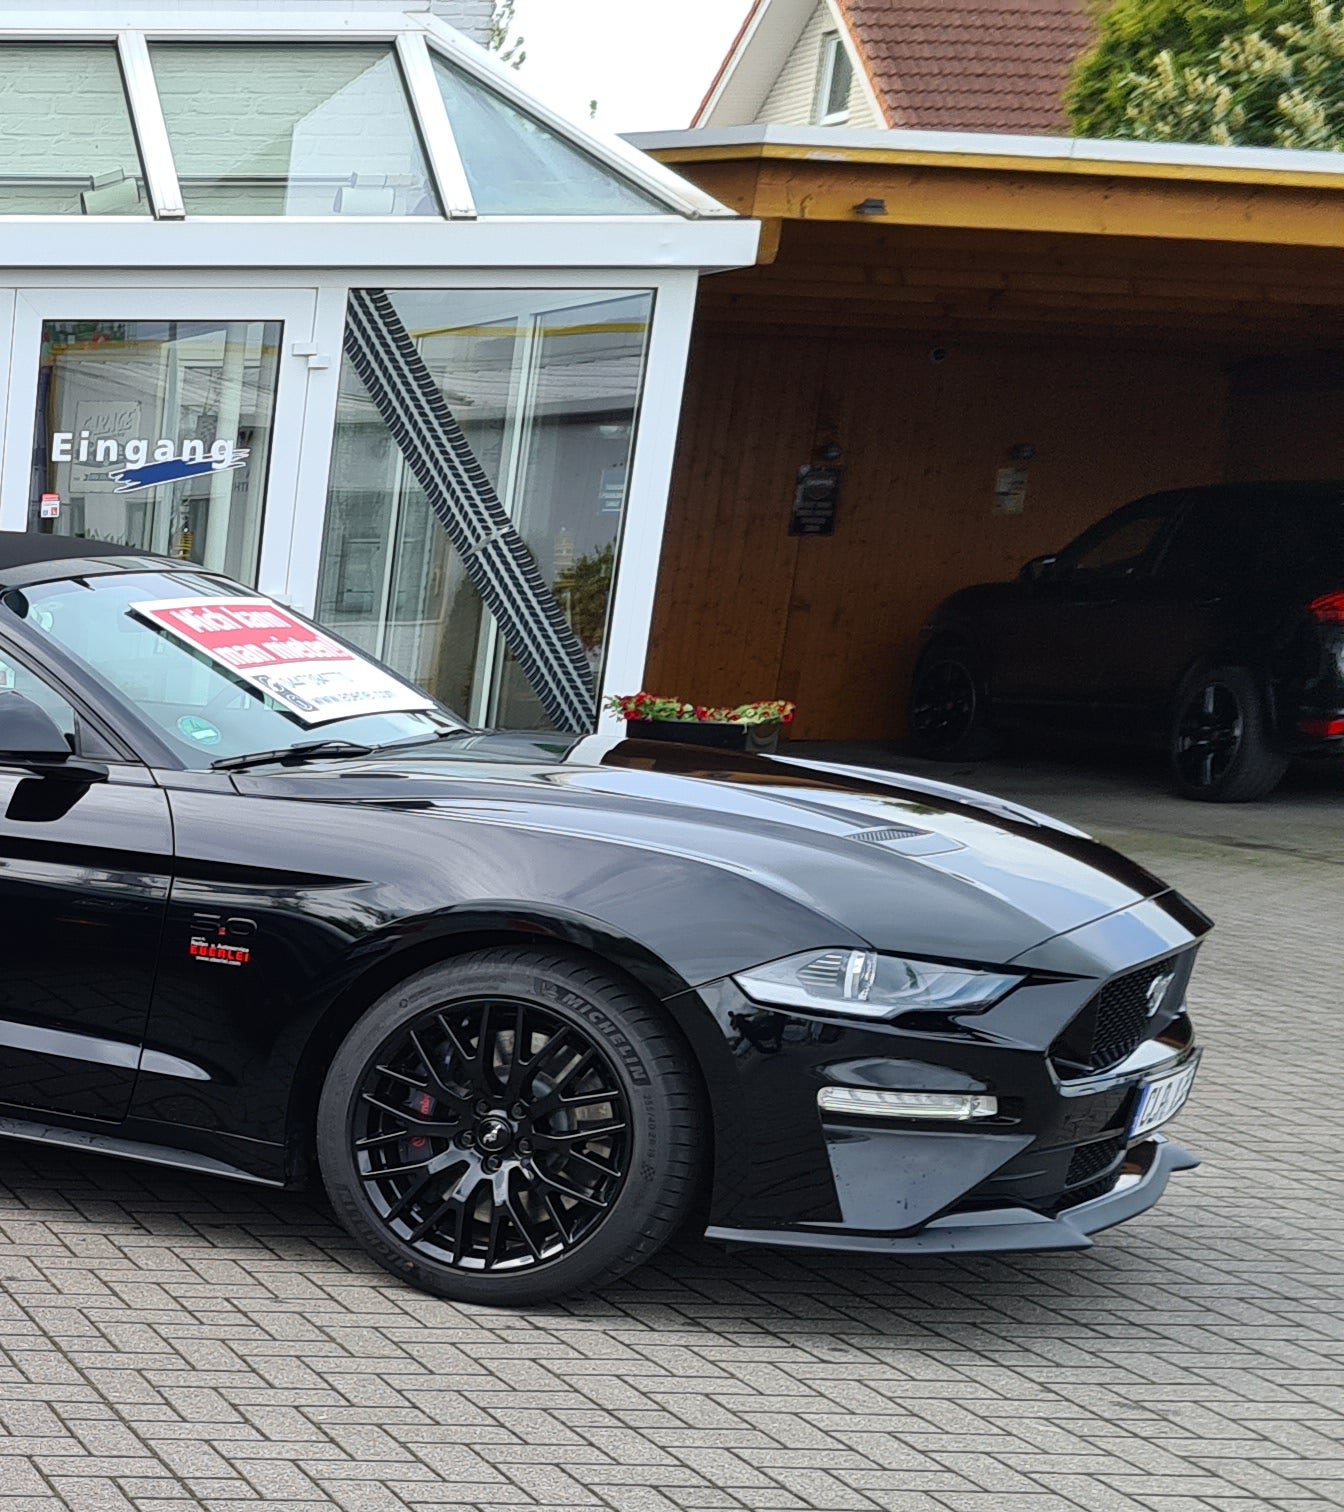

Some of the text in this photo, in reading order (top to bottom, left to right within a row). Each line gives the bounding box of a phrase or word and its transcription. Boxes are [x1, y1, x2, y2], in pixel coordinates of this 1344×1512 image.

[51, 430, 235, 469] Eingang
[213, 643, 277, 666] man
[562, 991, 648, 1083] MICHELIN
